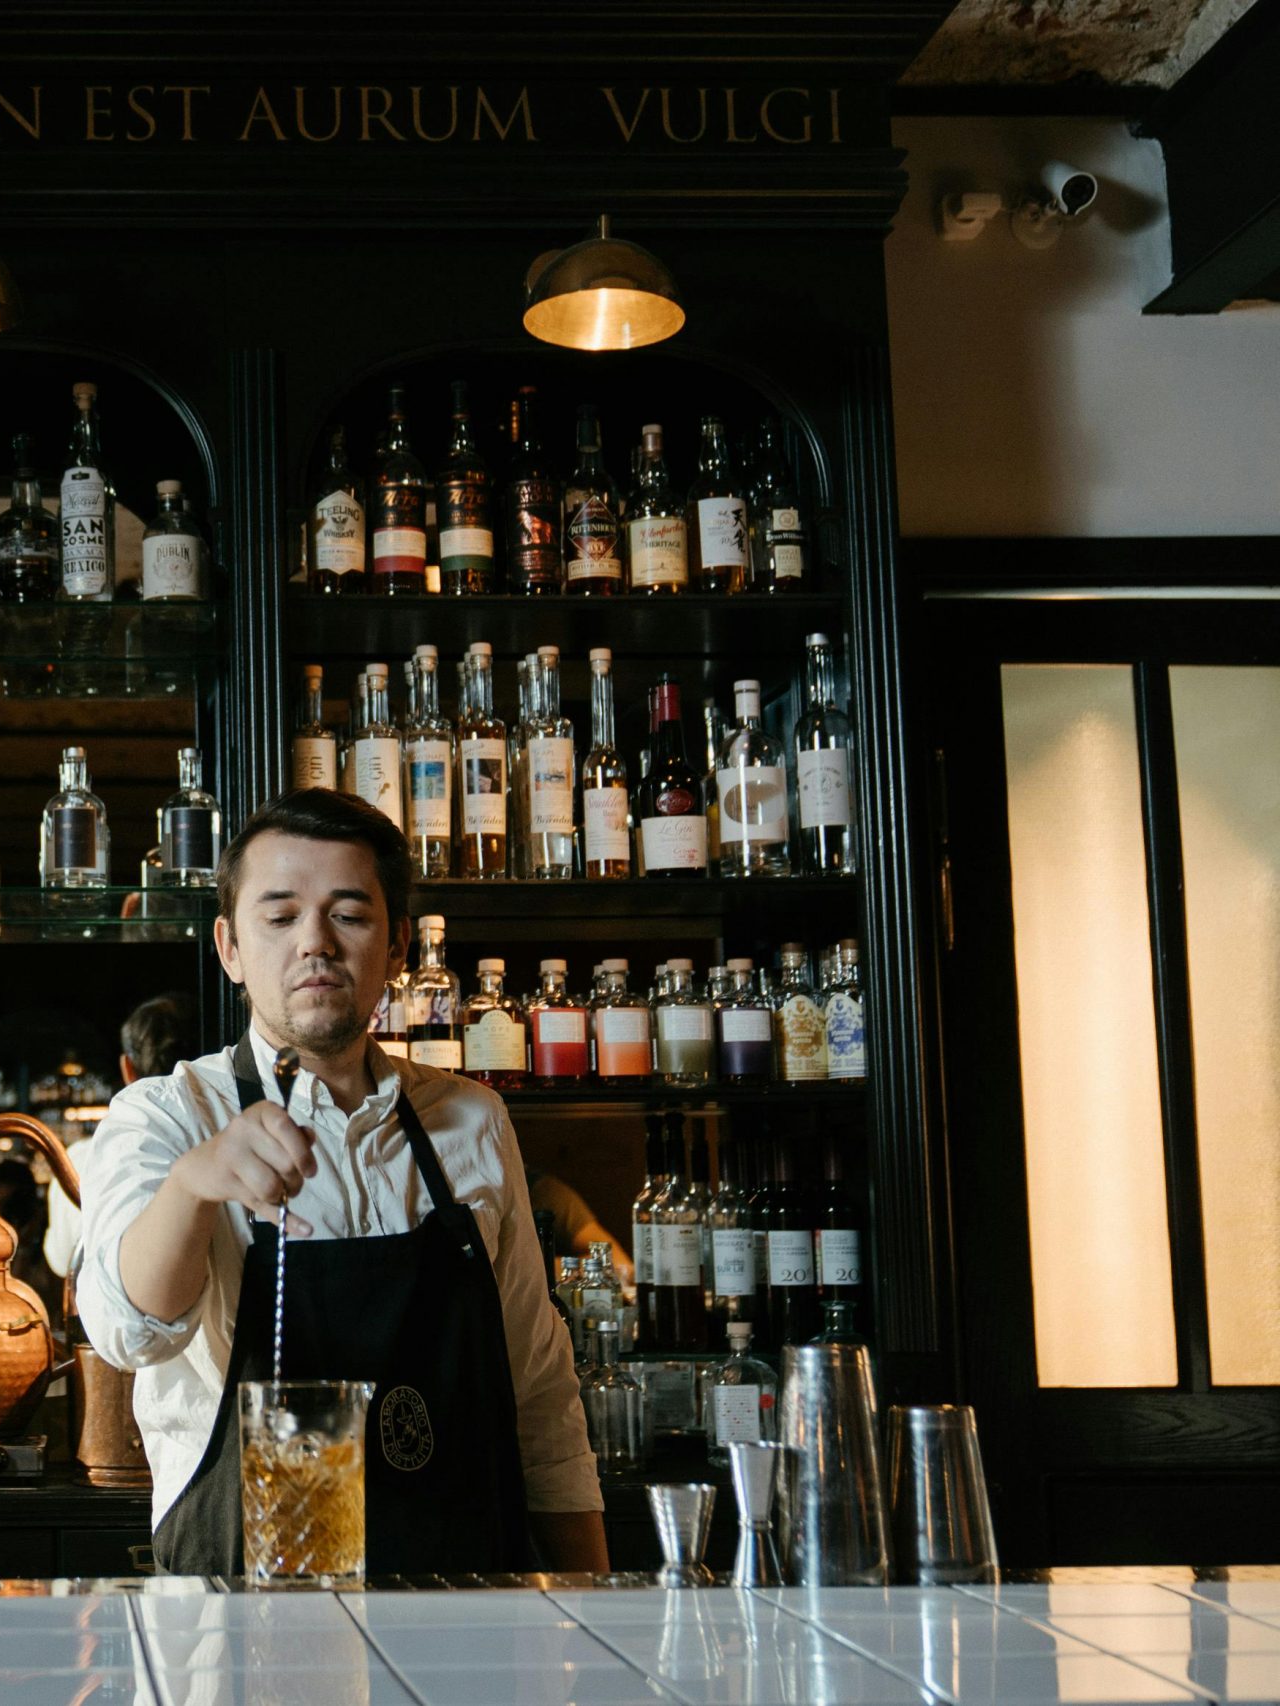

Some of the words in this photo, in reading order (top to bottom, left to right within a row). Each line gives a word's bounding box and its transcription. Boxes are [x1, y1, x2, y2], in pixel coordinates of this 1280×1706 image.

[81, 83, 214, 143] EST
[239, 83, 540, 143] AURUM
[603, 83, 846, 143] VULGI
[319, 505, 360, 522] TEELING
[63, 519, 104, 537] SAN
[63, 536, 104, 547] COSME
[63, 559, 105, 574] MEXICO
[383, 1389, 428, 1436] LABORATORIO
